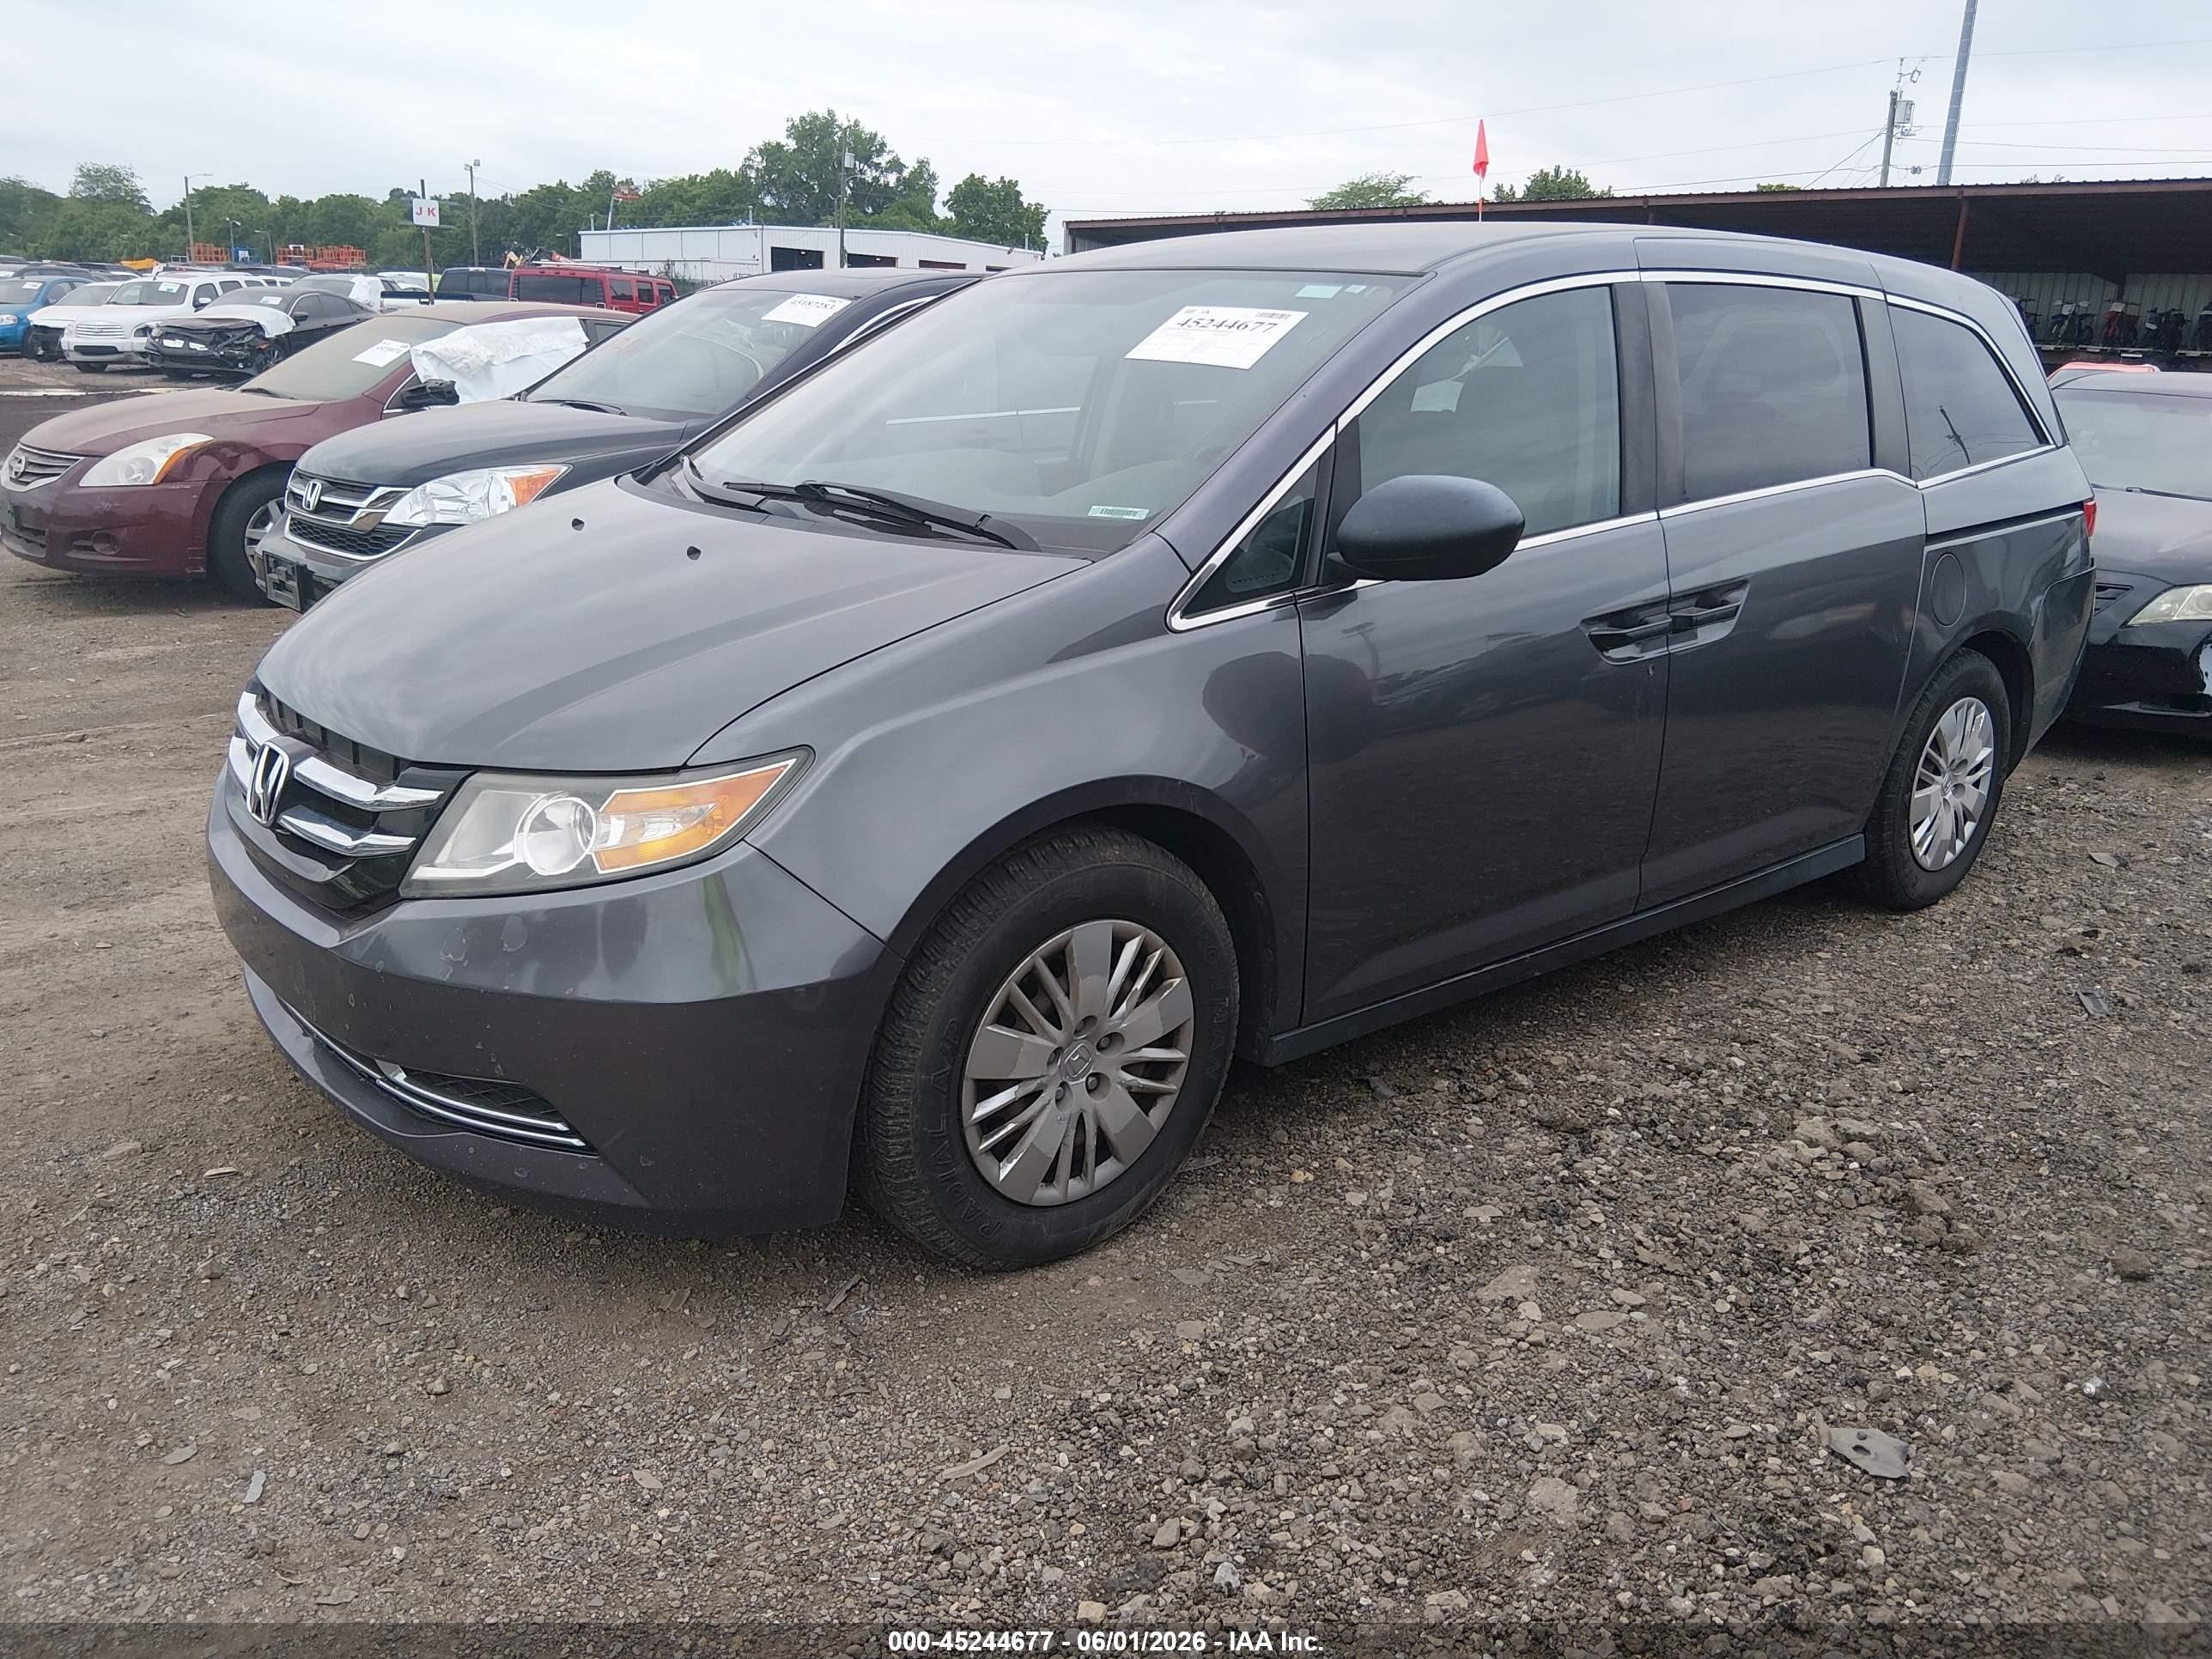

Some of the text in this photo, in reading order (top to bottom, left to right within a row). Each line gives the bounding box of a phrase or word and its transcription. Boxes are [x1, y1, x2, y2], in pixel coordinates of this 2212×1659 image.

[416, 206, 436, 216] J K
[1176, 317, 1279, 333] 45244677
[922, 1113, 1002, 1238] RADIAL
